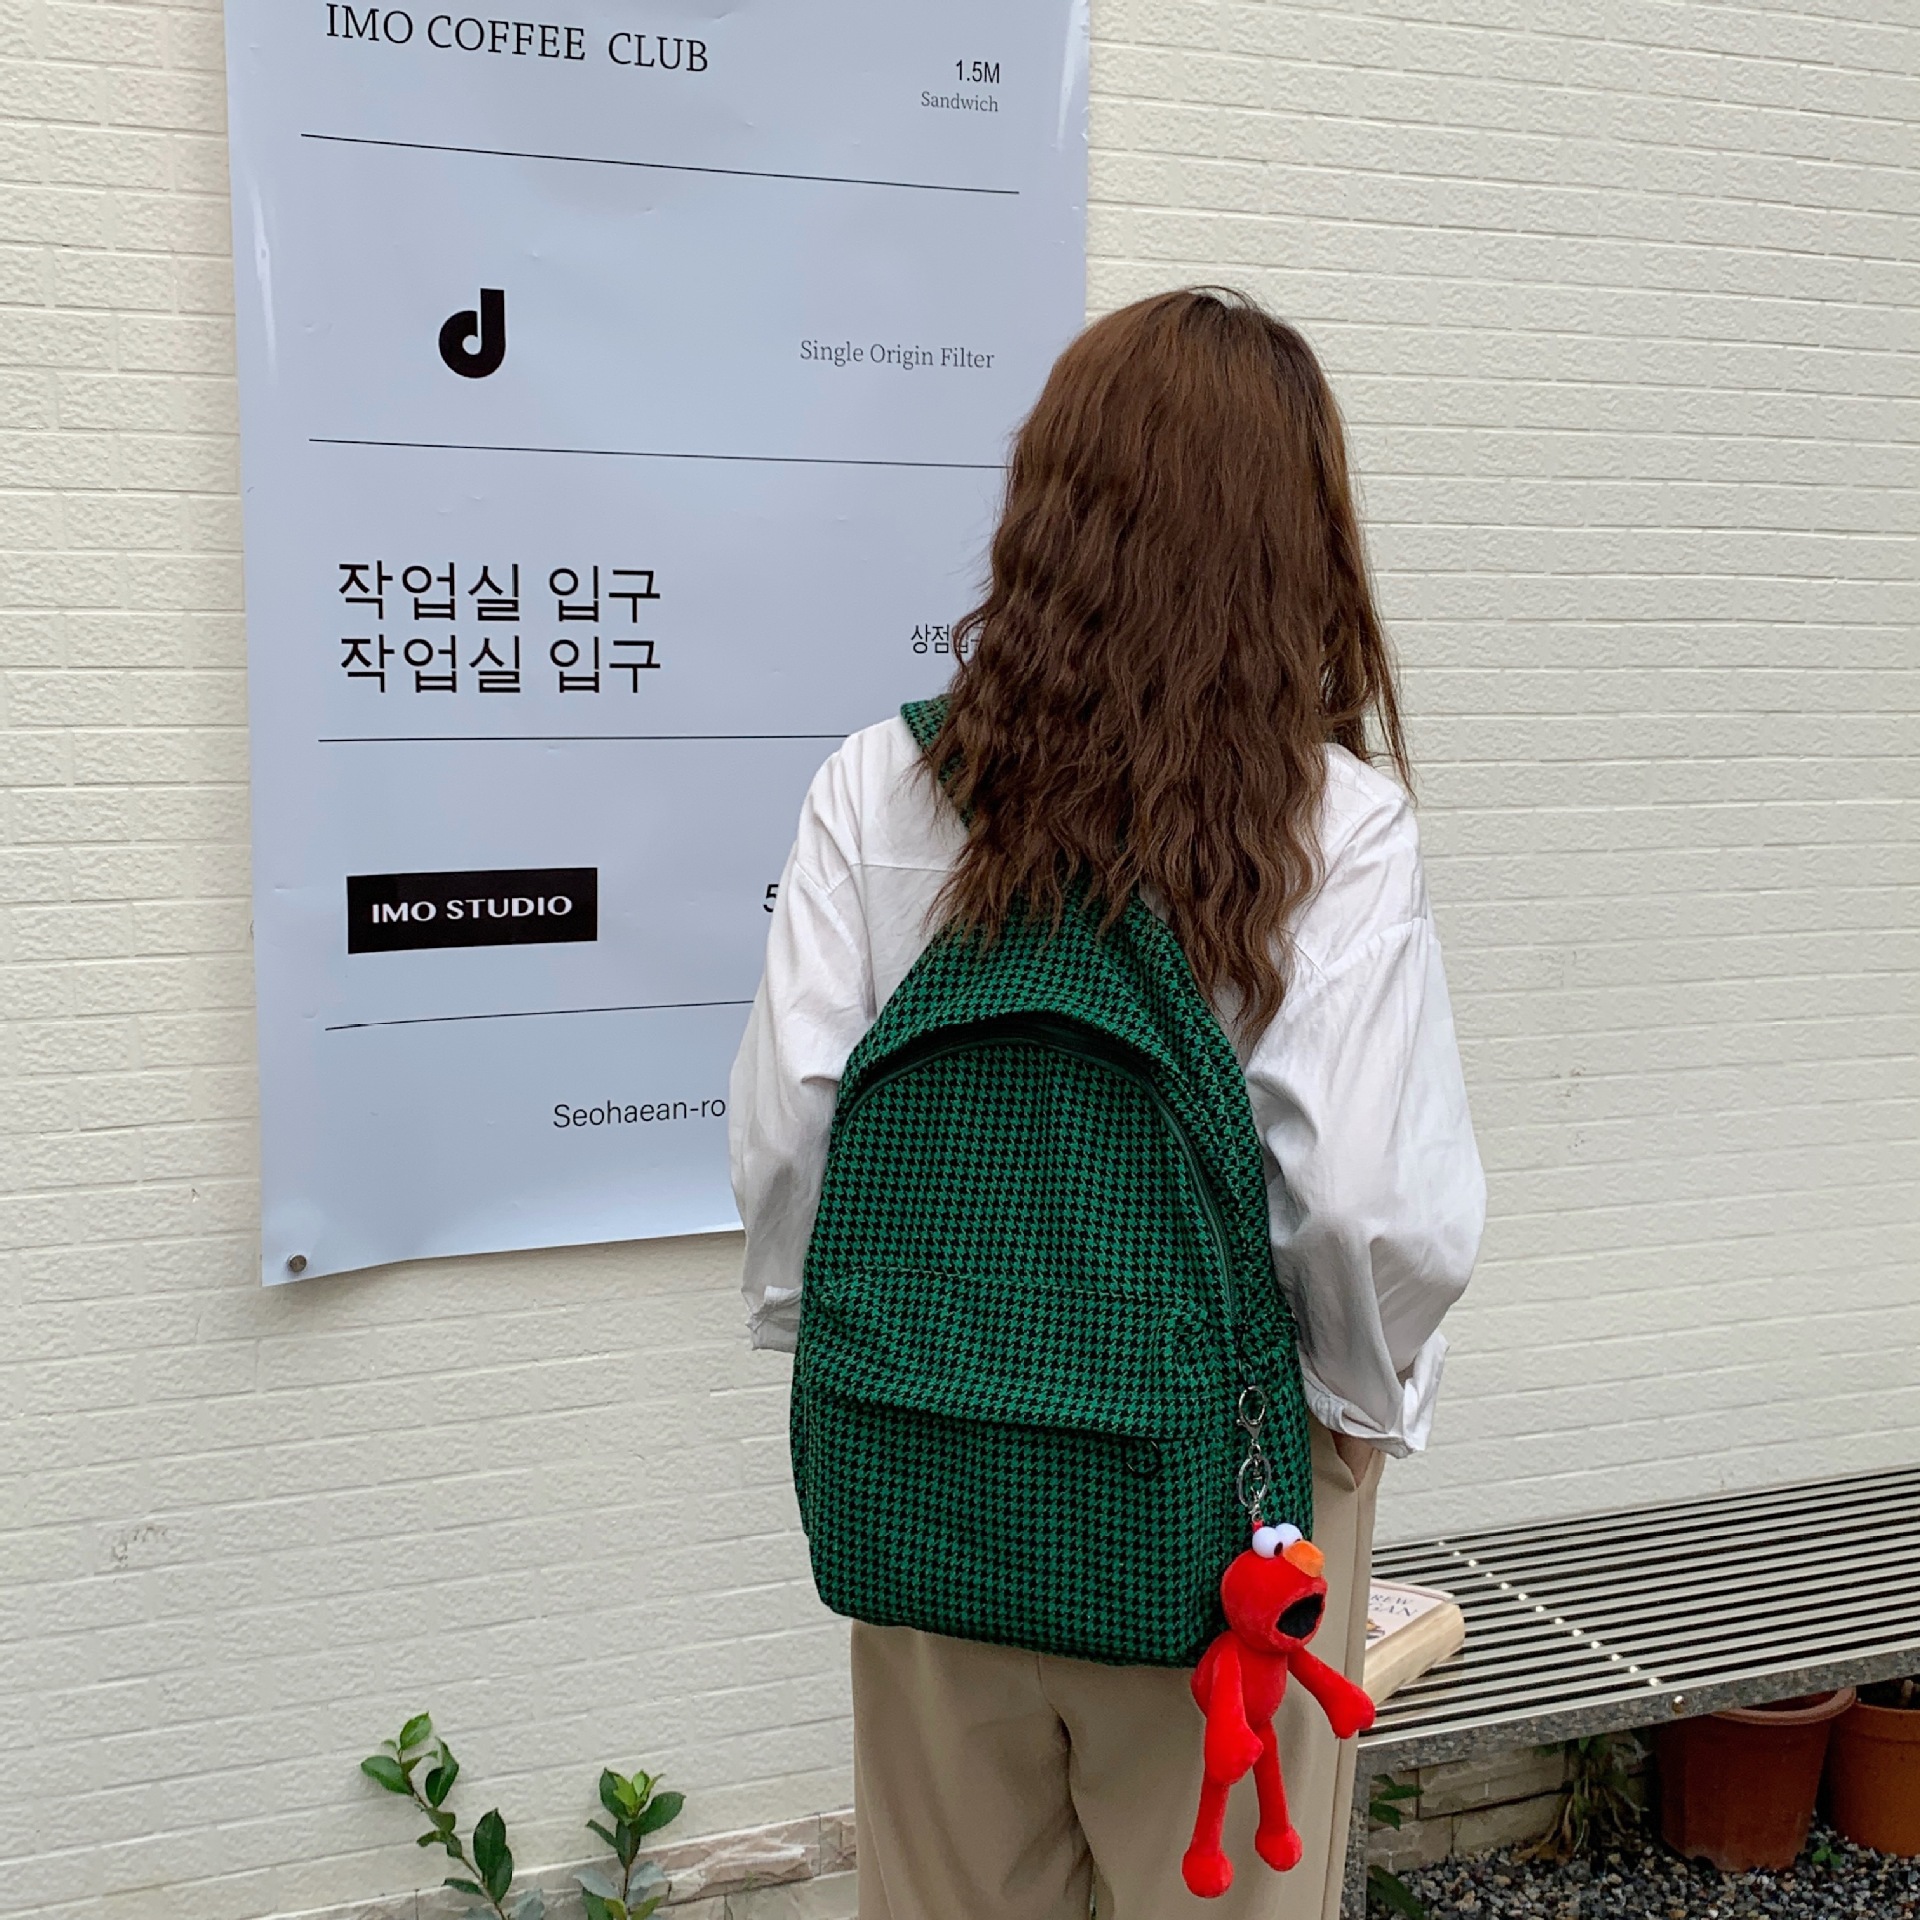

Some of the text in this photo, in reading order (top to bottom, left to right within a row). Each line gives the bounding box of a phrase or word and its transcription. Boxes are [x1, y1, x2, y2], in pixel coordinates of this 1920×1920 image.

[326, 2, 709, 72] IMO COFFEE CLUB
[955, 59, 1001, 84] 1.5M
[921, 91, 999, 114] Sandwich
[800, 339, 995, 371] Single Origin Filter
[338, 559, 661, 624] 작업실 입구
[340, 634, 661, 694] 작업실 입구
[371, 895, 574, 924] IMO STUDIO
[553, 1099, 726, 1128] Seohaean-ro
